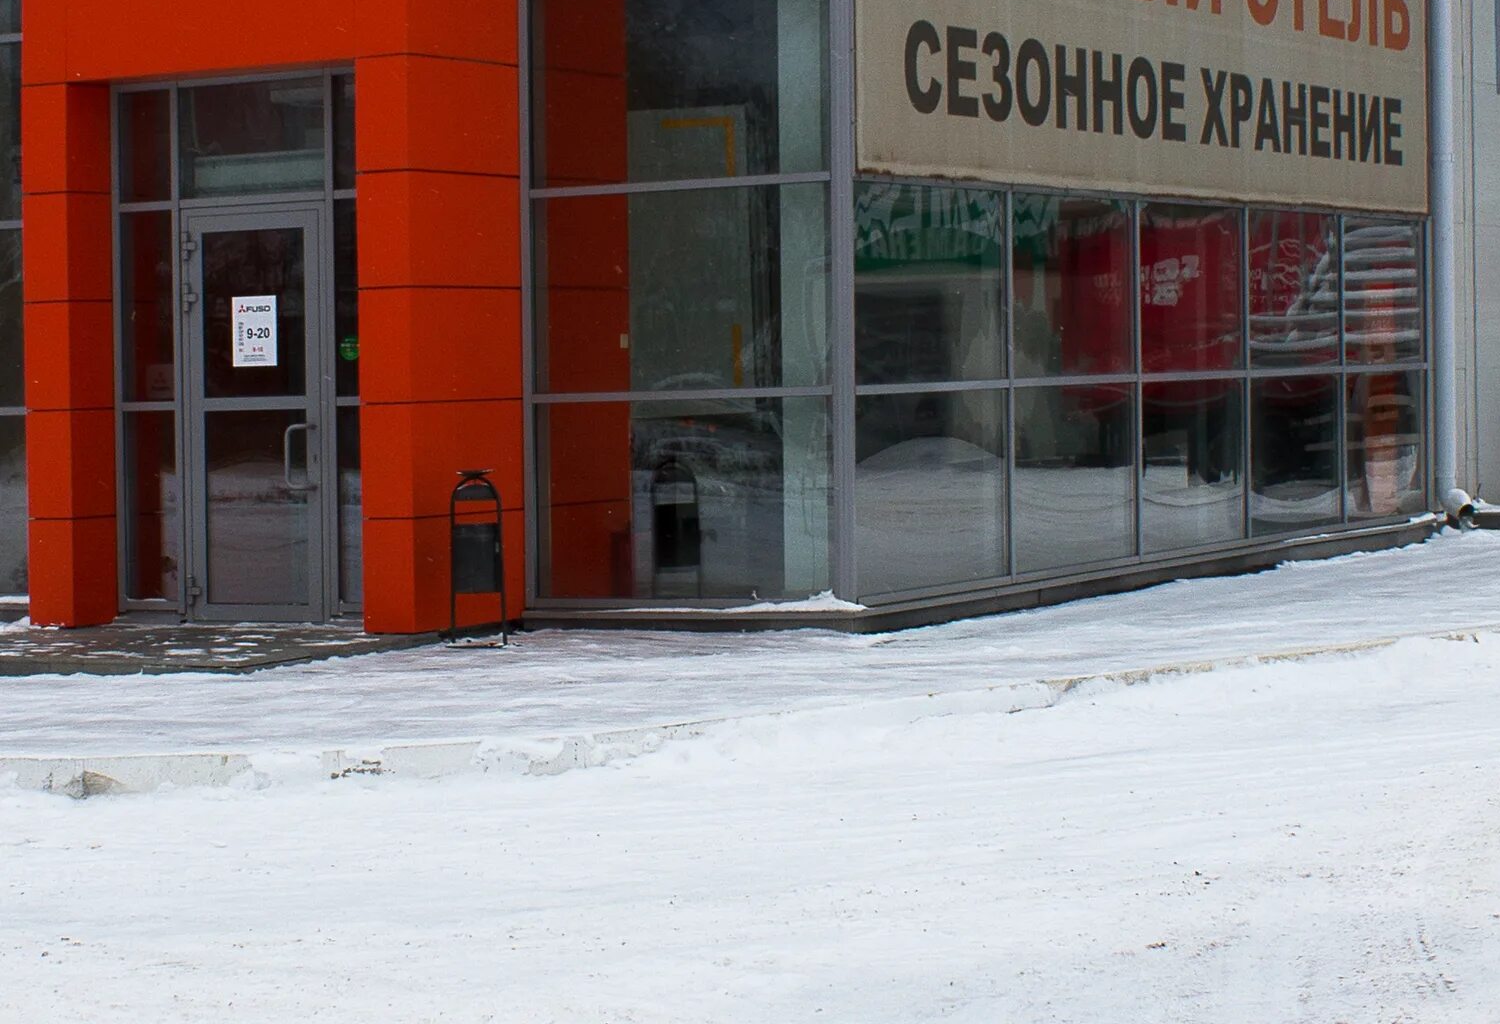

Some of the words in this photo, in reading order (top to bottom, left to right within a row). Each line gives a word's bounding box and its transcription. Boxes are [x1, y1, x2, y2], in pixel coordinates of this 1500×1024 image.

[904, 19, 1187, 143] СЕЗОННОЕ
[1200, 67, 1403, 166] ХРАНЕНИЕ
[246, 305, 271, 313] FUSO
[247, 327, 270, 339] 9-20
